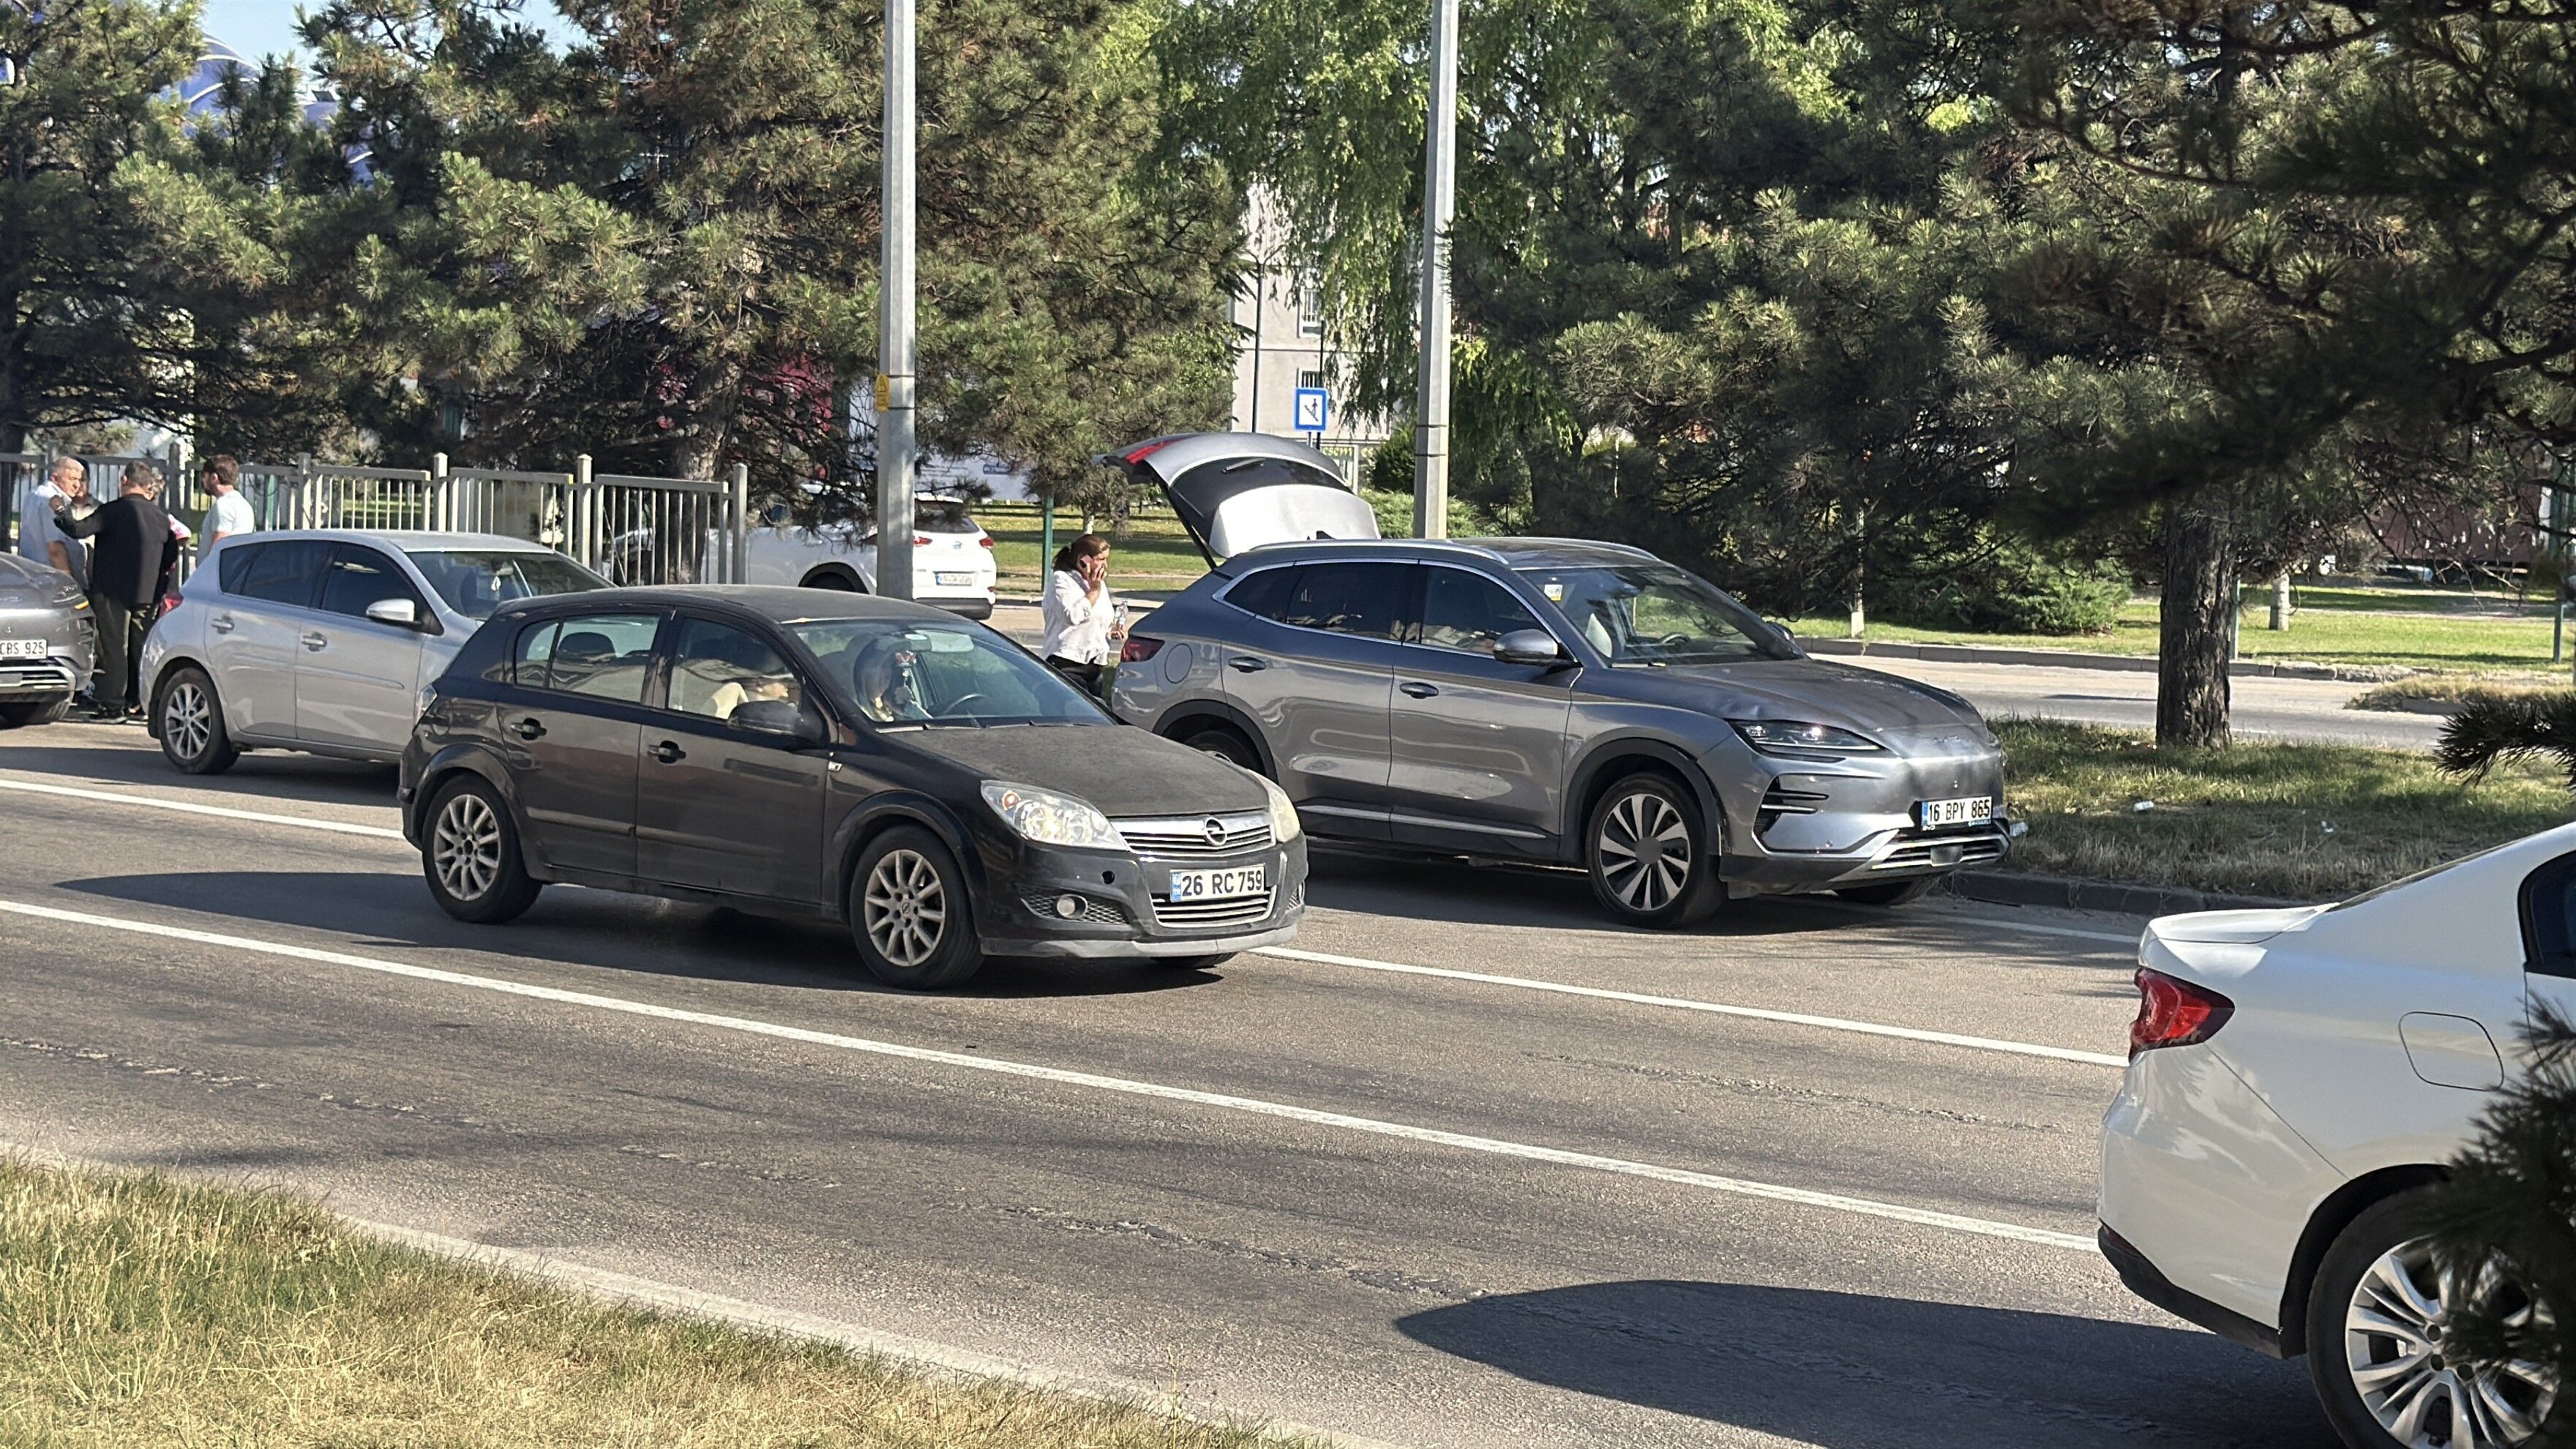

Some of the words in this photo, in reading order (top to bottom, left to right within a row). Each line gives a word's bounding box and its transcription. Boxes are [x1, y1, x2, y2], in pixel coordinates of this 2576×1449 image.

[0, 642, 19, 656] CBS
[25, 641, 45, 655] 925
[1929, 804, 1940, 822] 16
[1945, 801, 1966, 820] BPY
[1971, 799, 1991, 819] 865
[1182, 875, 1204, 897] 26
[1212, 872, 1235, 894] RC
[1238, 870, 1262, 893] 759
